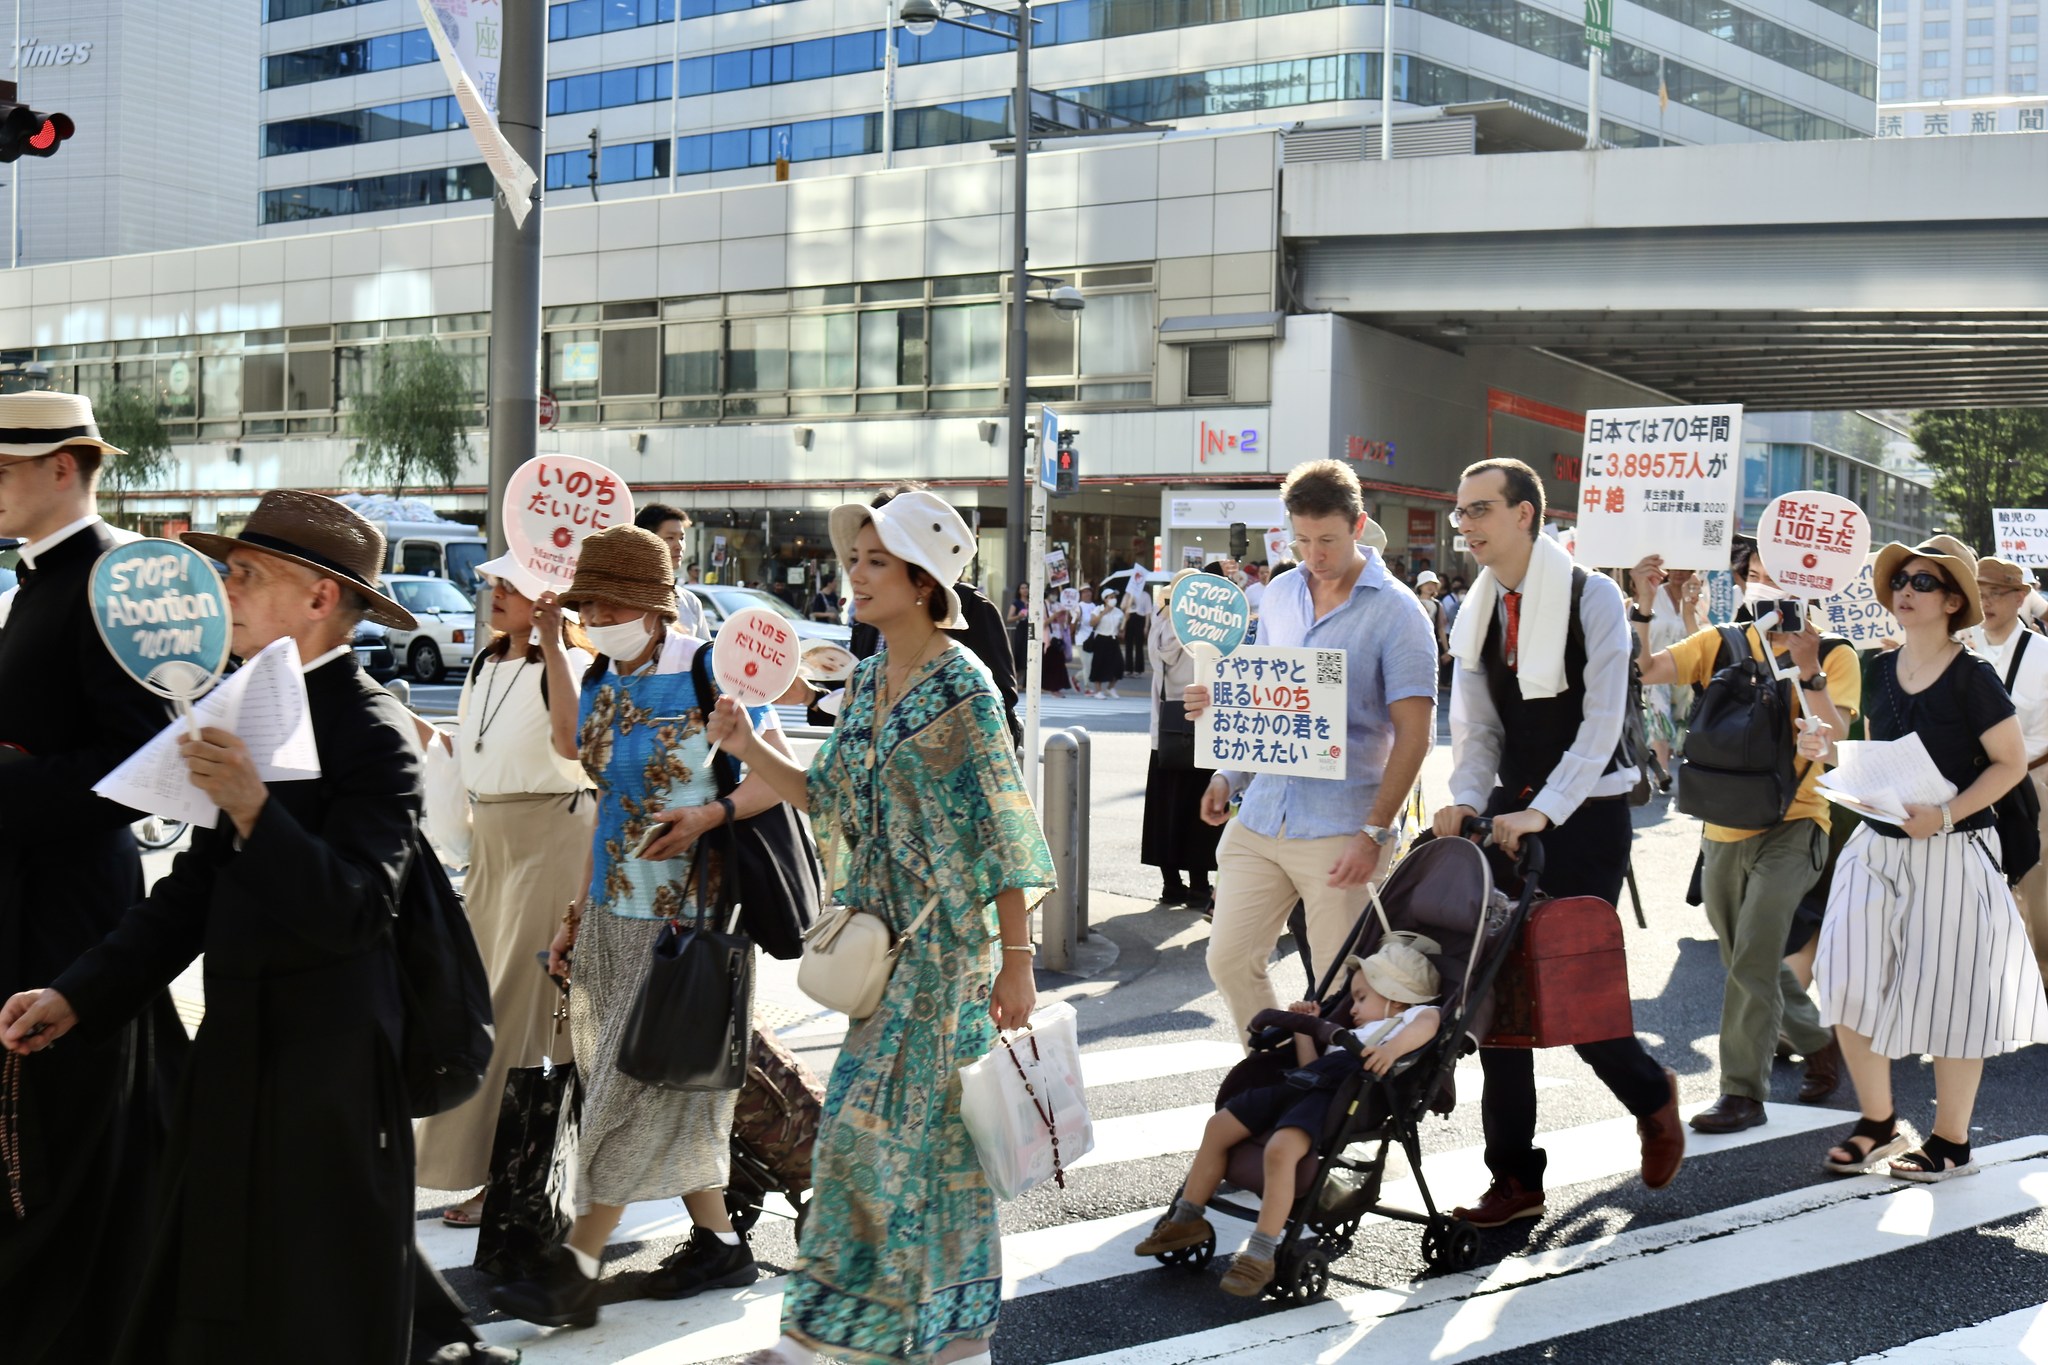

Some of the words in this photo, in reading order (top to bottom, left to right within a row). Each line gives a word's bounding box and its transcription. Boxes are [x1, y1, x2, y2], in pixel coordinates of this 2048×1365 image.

[9, 38, 93, 70] Times
[1878, 108, 2044, 138] 読売新聞
[1589, 416, 1731, 444] 日本では70年間
[538, 463, 616, 506] いのち
[1643, 490, 1686, 501] 厚生労働省
[527, 490, 611, 531] だいじに
[1583, 485, 1625, 514] 中絶
[1777, 499, 1858, 529] 胚だって
[1998, 511, 2036, 523] 胎児の
[1774, 519, 1856, 548] いのちだ
[110, 553, 191, 593] STOP!
[106, 588, 220, 628] Abortion
[1186, 581, 1239, 606] STOP!
[1176, 595, 1243, 629] Abortion
[1827, 602, 1893, 624] 君らの
[750, 616, 788, 645] いのち
[1187, 618, 1230, 643] NOW!
[735, 631, 786, 667] だいじに
[1215, 656, 1307, 684] すやすやと
[1213, 682, 1311, 710] 眠るいのち
[1212, 709, 1331, 740] おなかの君を
[1212, 736, 1308, 764] むかえたい
